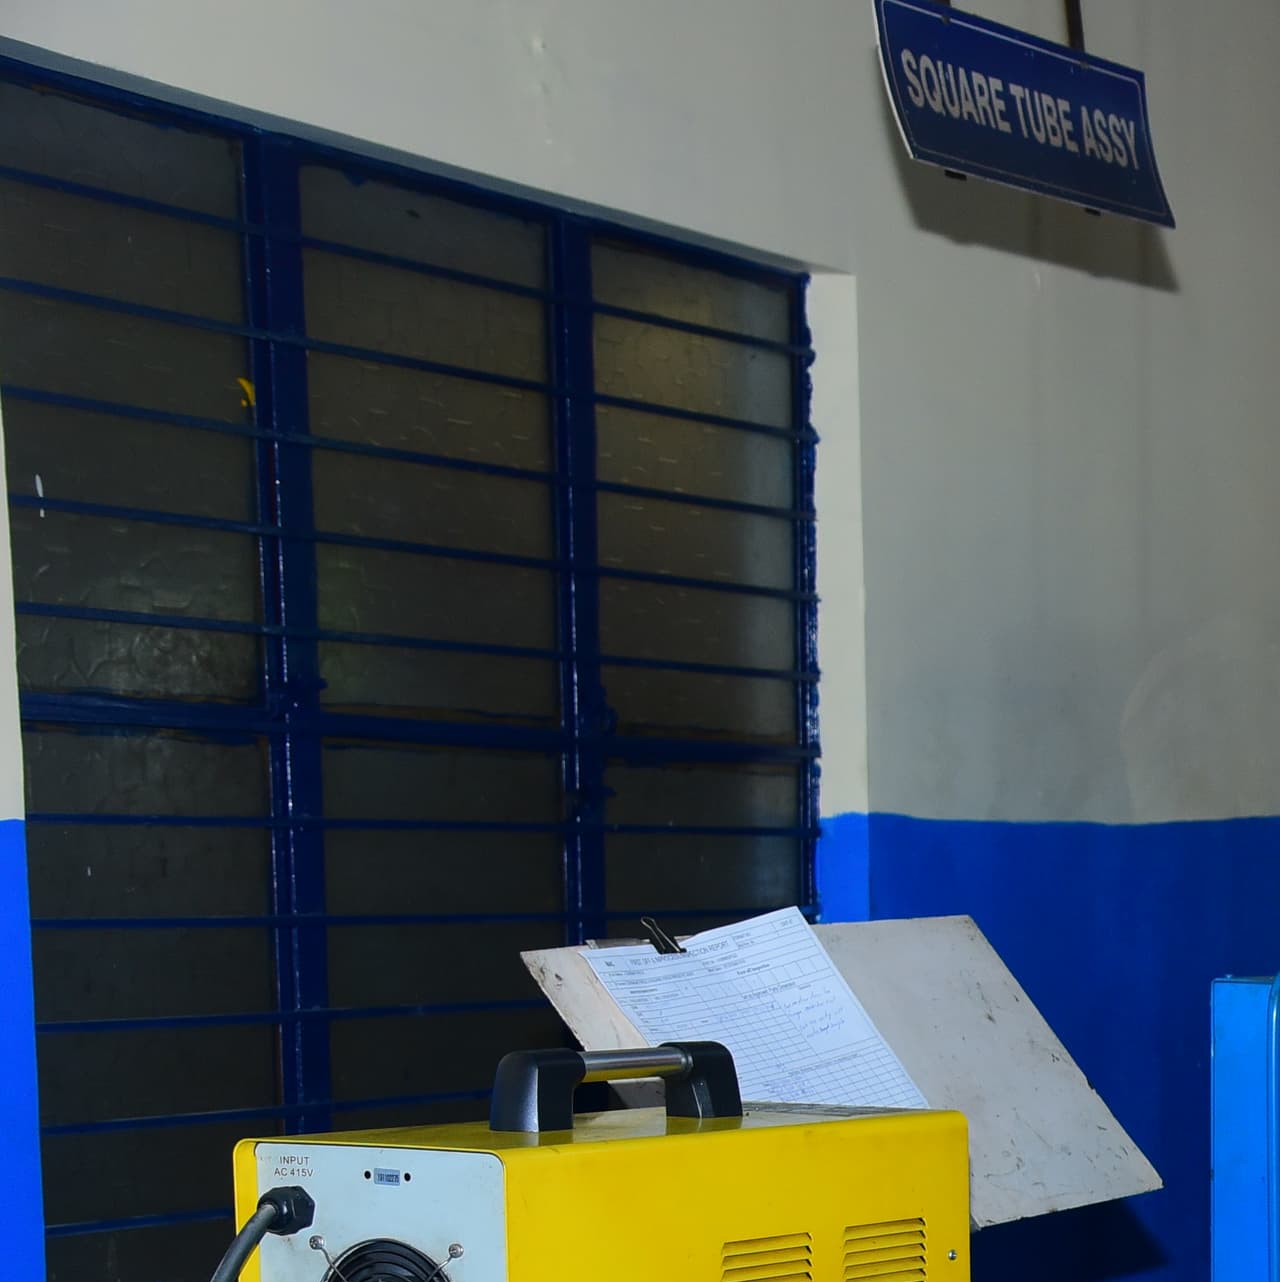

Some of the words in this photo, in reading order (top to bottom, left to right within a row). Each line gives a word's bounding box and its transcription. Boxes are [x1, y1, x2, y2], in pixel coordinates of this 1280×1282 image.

[900, 48, 1012, 134] SQUARE
[1009, 83, 1080, 154] TUBE
[1081, 105, 1141, 171] ASSY
[279, 1156, 310, 1166] INPUT
[274, 1167, 288, 1177] AC
[289, 1168, 314, 1177] 415V
